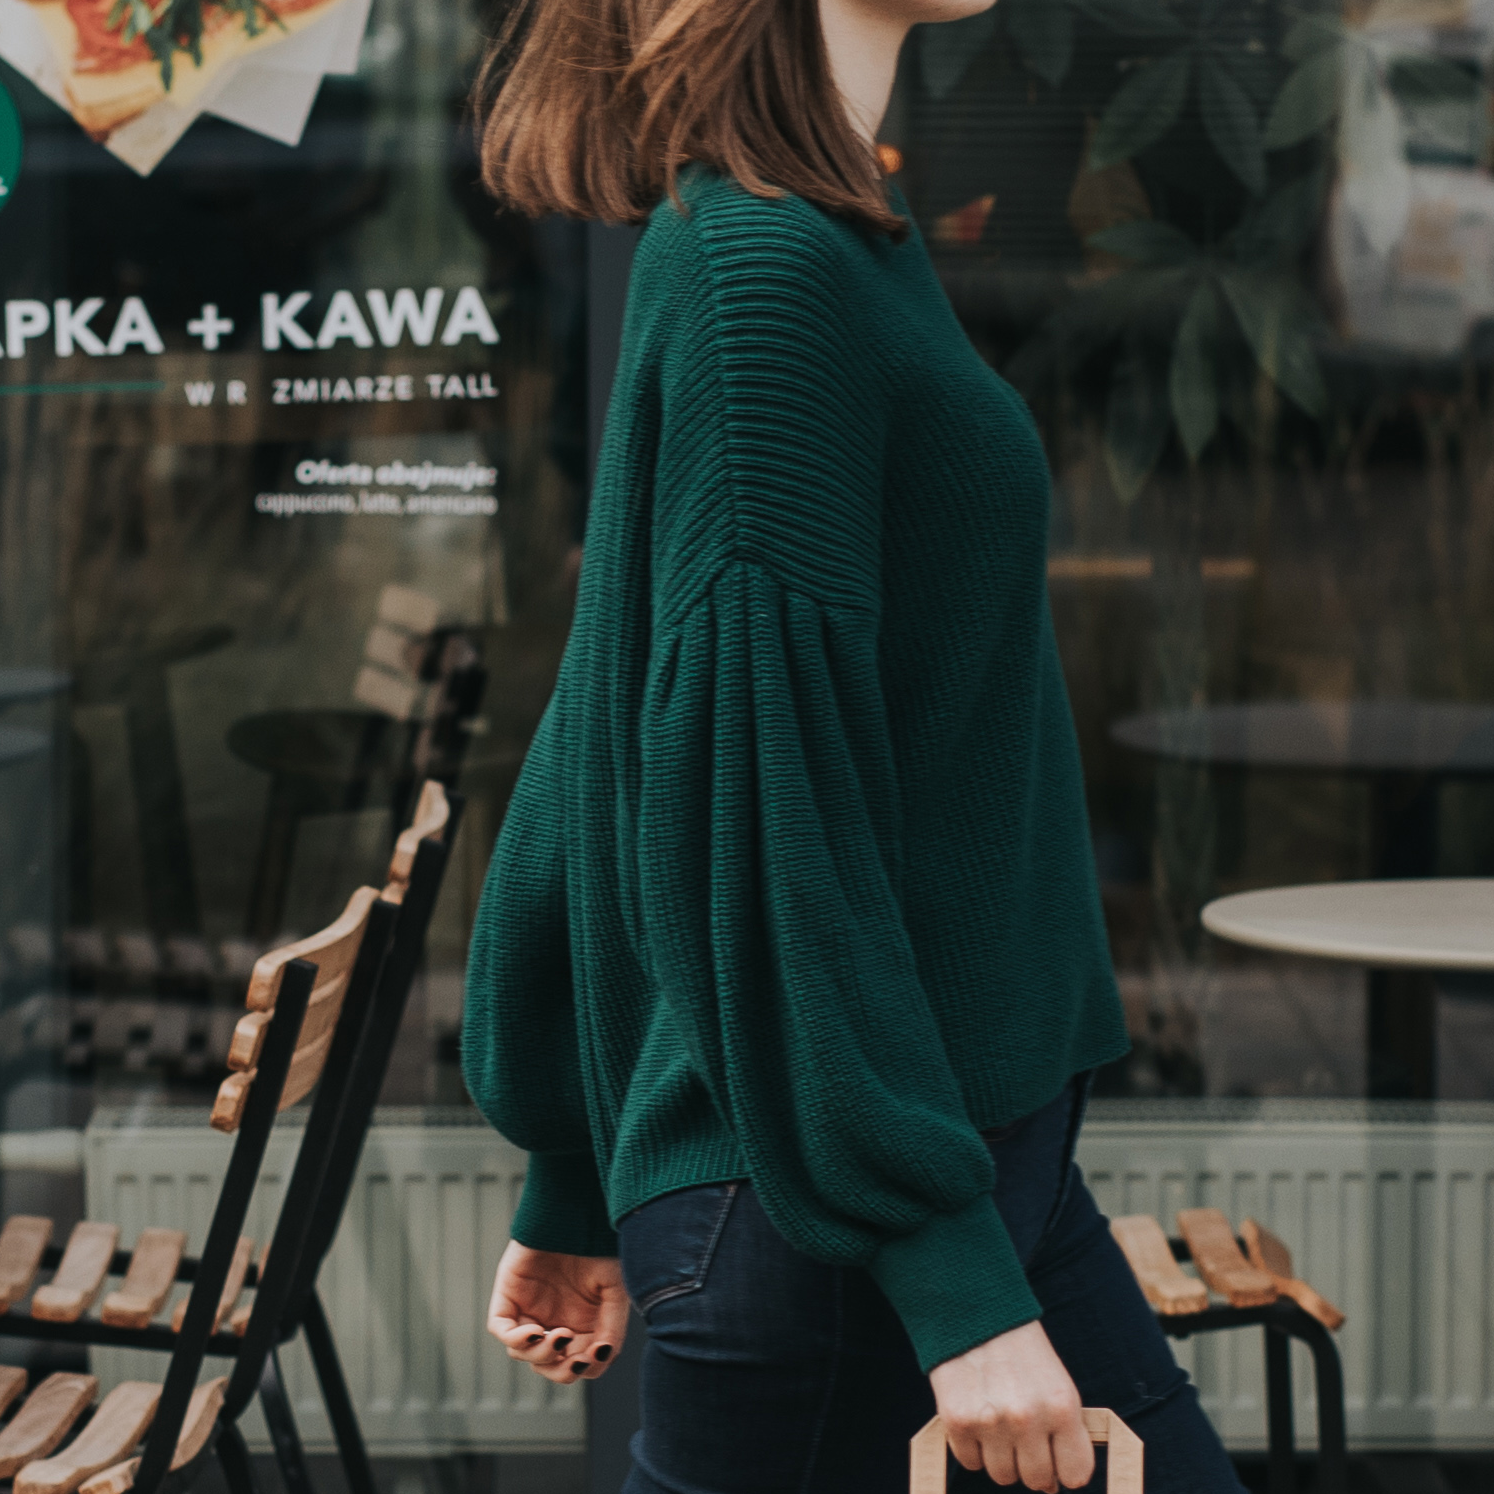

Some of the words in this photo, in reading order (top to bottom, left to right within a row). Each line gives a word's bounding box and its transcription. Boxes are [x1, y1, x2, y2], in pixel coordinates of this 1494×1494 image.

[187, 304, 234, 351] +
[262, 285, 500, 351] KAWA
[425, 373, 497, 399] TALL
